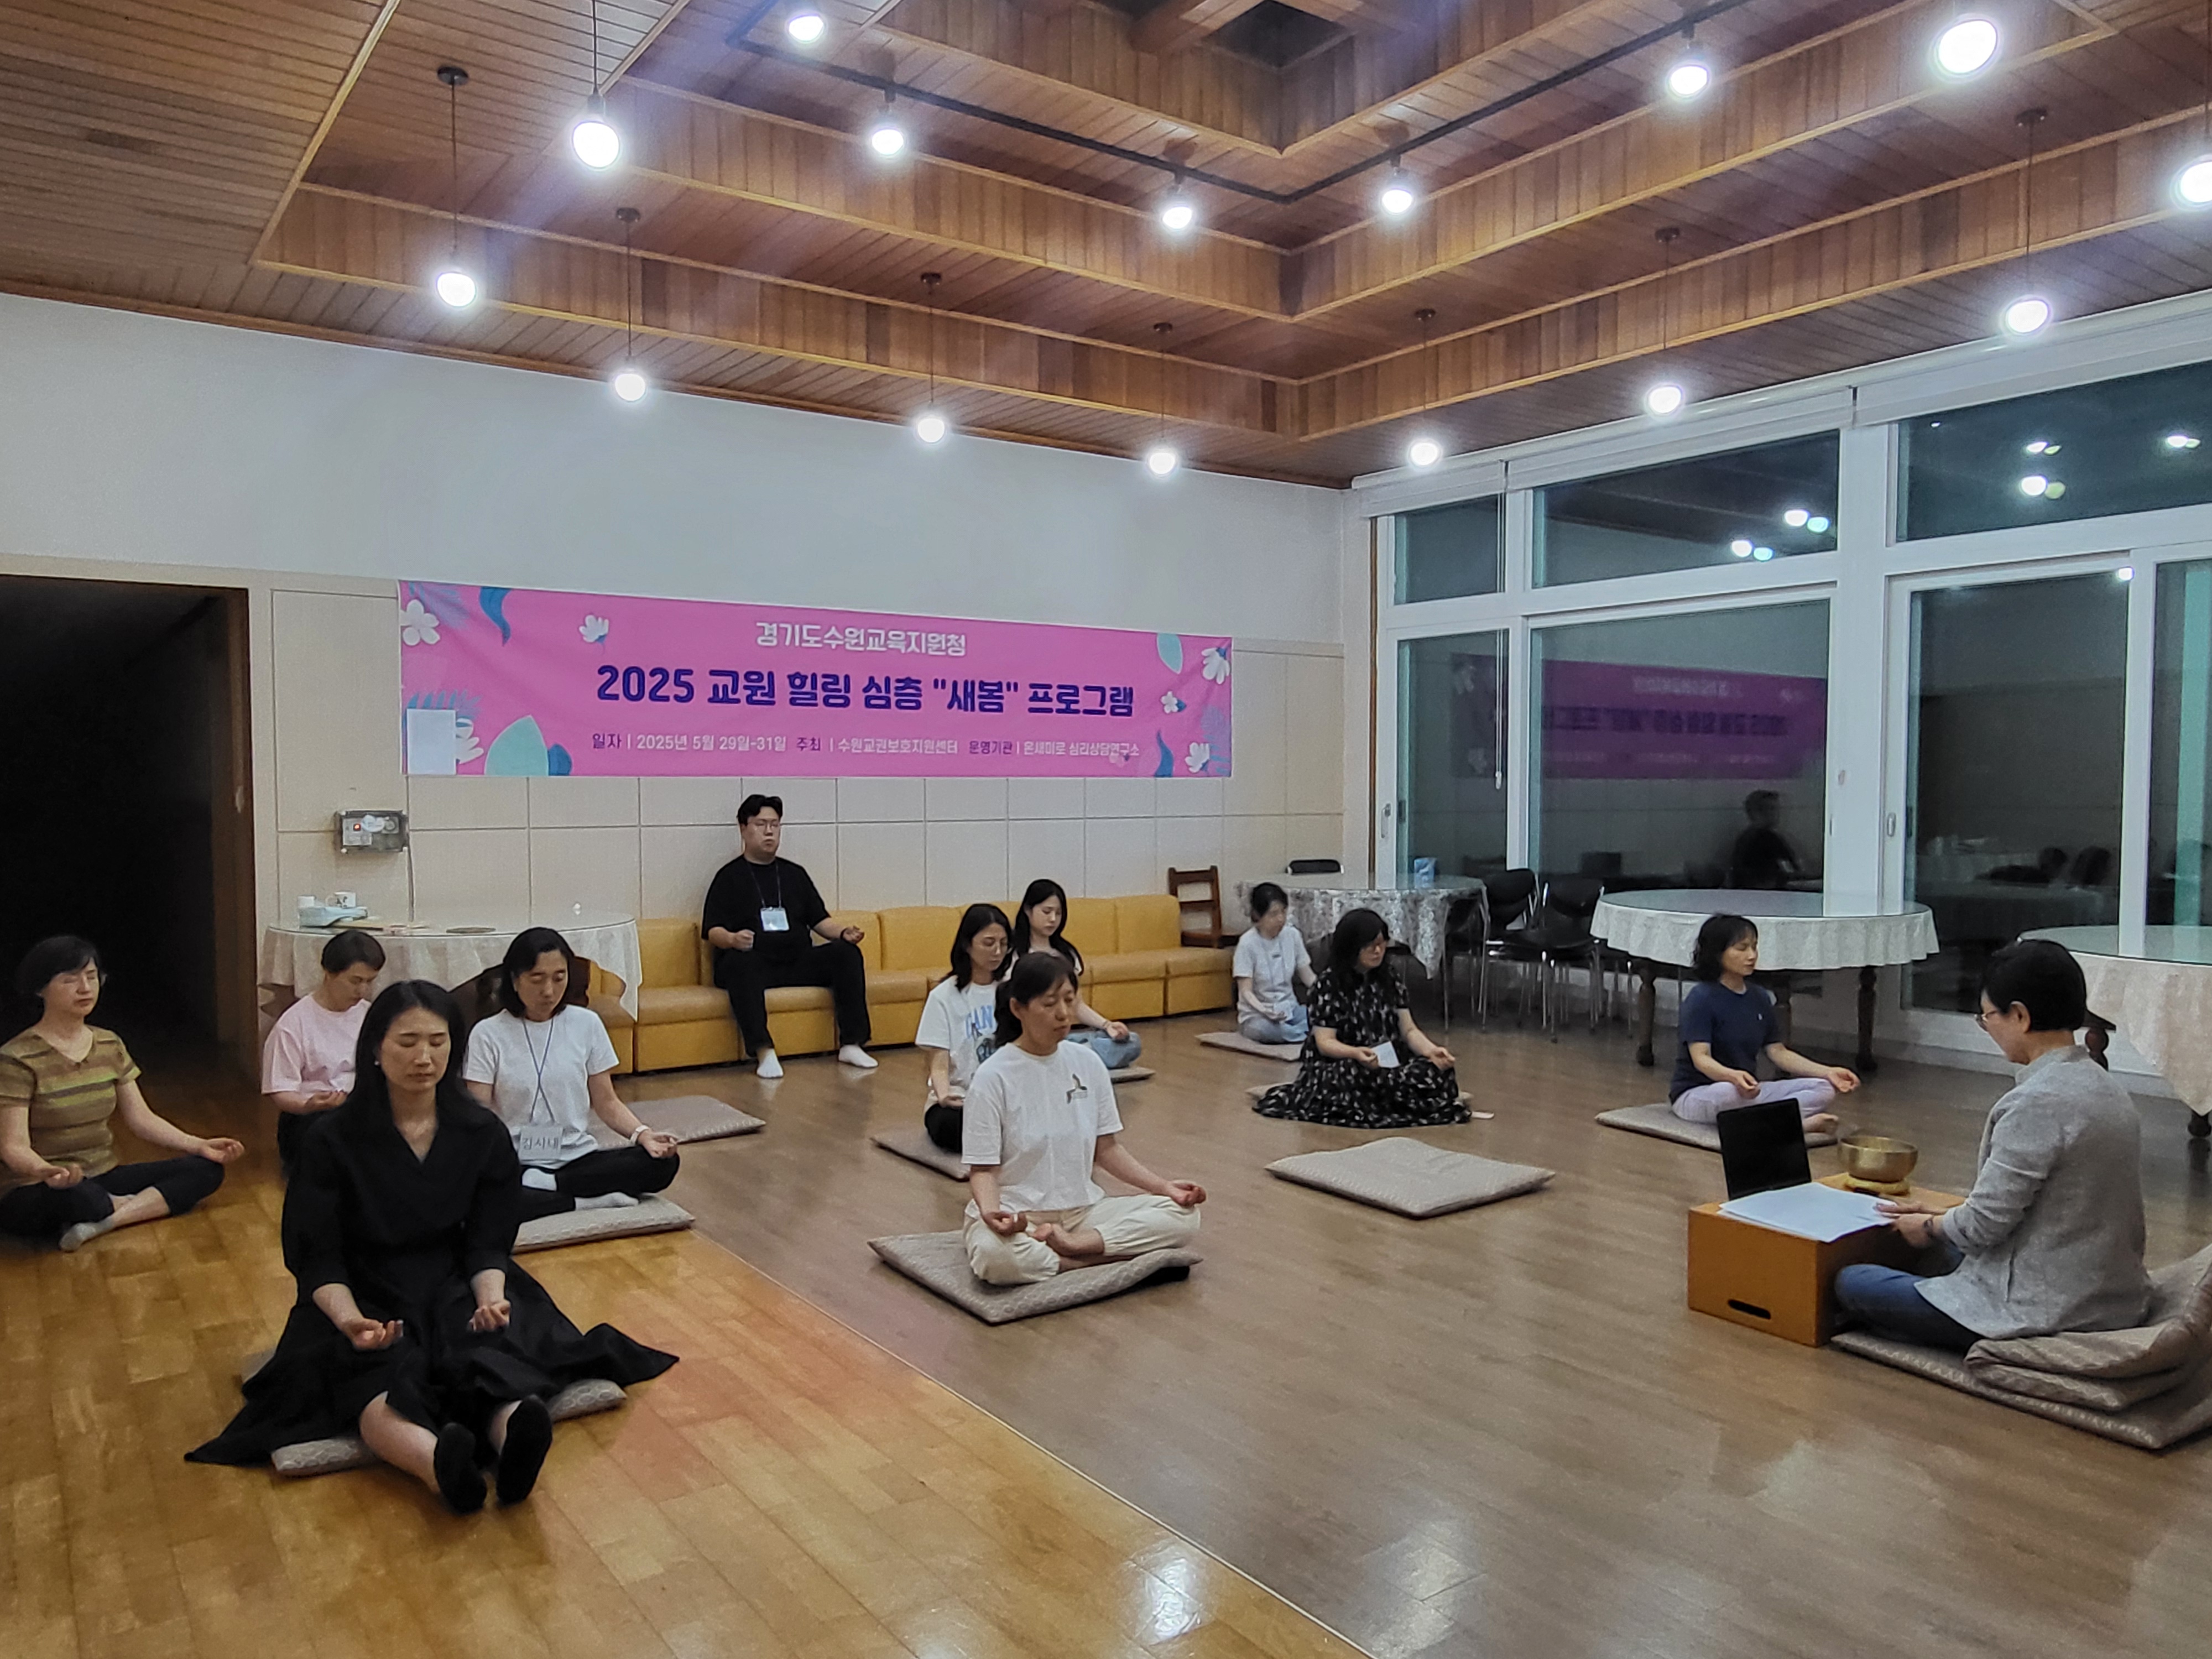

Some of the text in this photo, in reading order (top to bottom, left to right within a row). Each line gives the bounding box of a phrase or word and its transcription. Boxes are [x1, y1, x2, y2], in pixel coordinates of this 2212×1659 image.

[756, 622, 966, 656] 경기도수원교육지원청
[597, 665, 1134, 717] 2025 교원 힐링 심층 "새봄" 프로그램
[592, 733, 622, 749] 일자
[637, 734, 687, 750] 2025년
[693, 735, 714, 751] 5월
[719, 736, 786, 752] 29일-31일
[796, 737, 821, 752] 주최
[838, 738, 958, 754] 수원교권보호지원센터
[969, 740, 1013, 754] 운영기관
